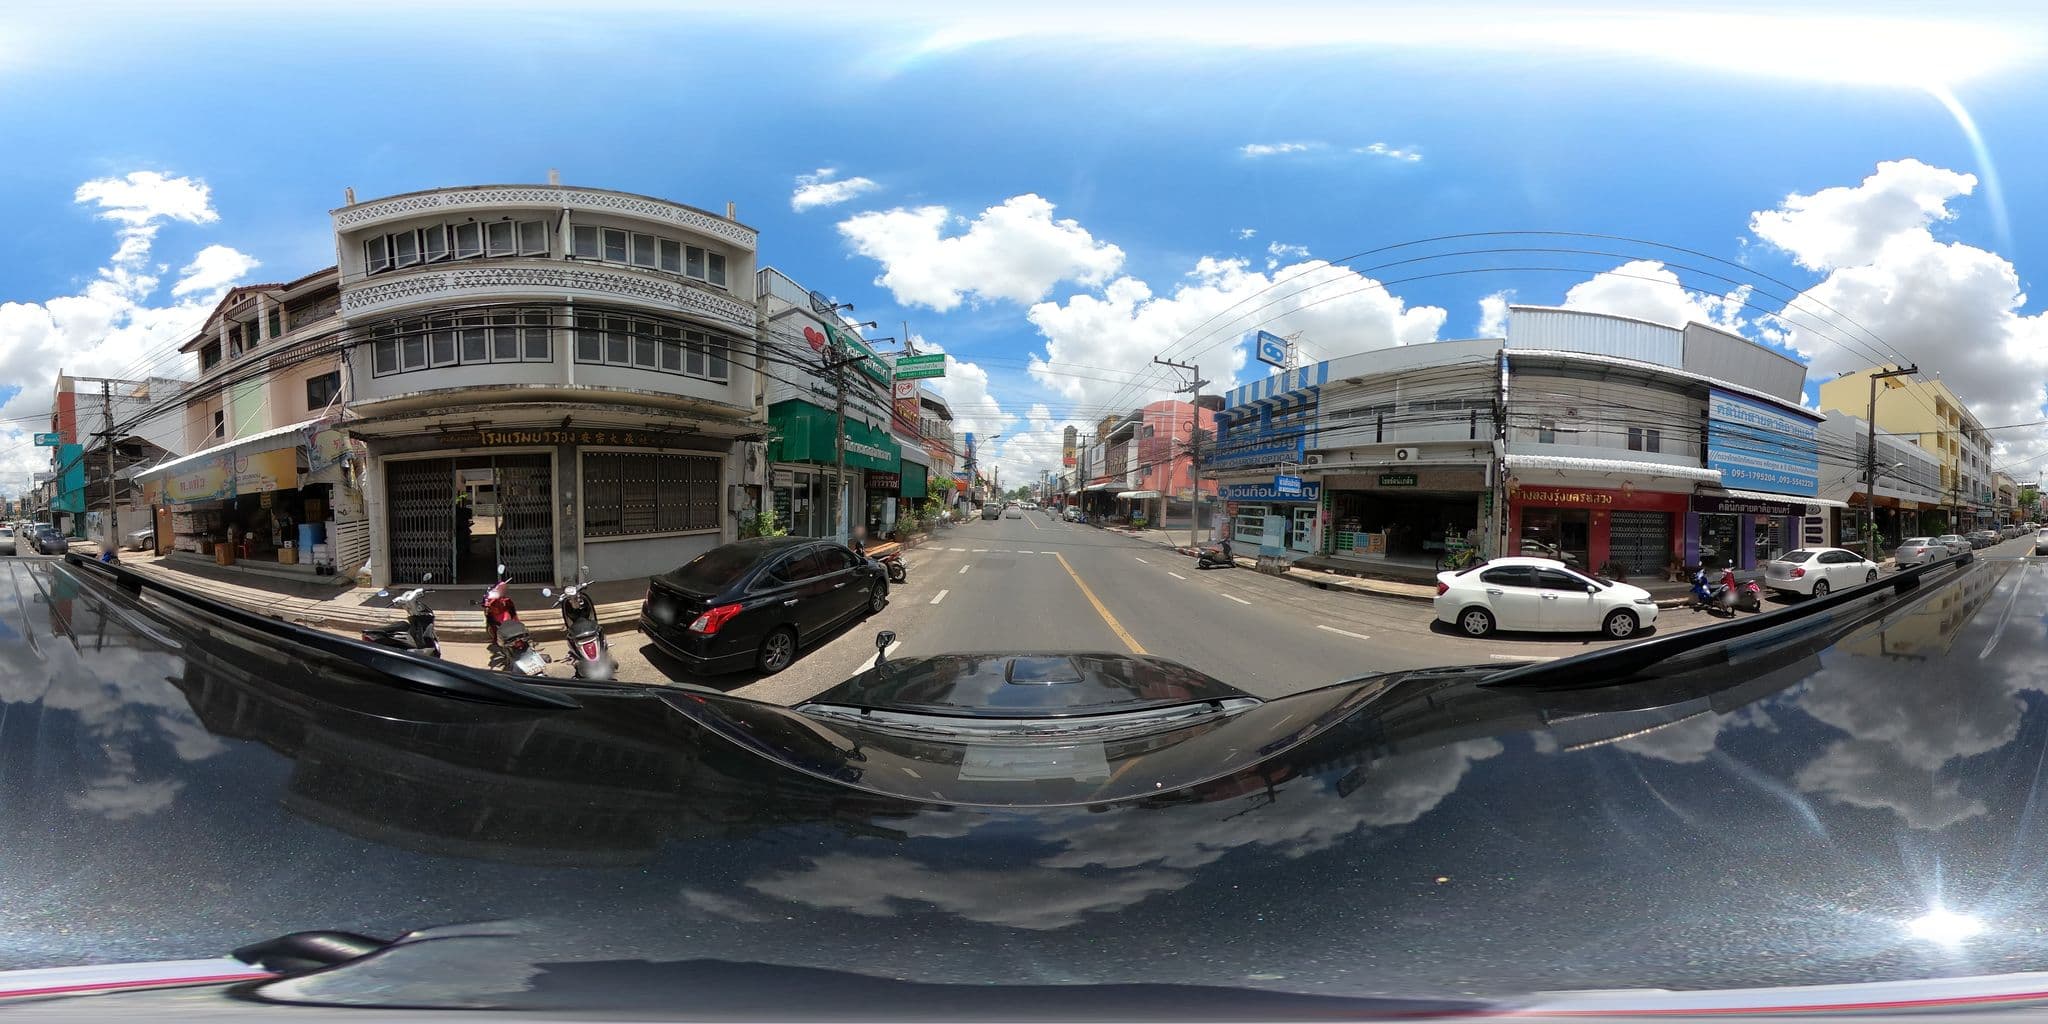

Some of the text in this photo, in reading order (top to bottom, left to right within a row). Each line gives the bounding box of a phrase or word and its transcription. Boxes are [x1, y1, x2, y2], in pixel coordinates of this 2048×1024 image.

[479, 431, 576, 445] โรงแรมบรรจง
